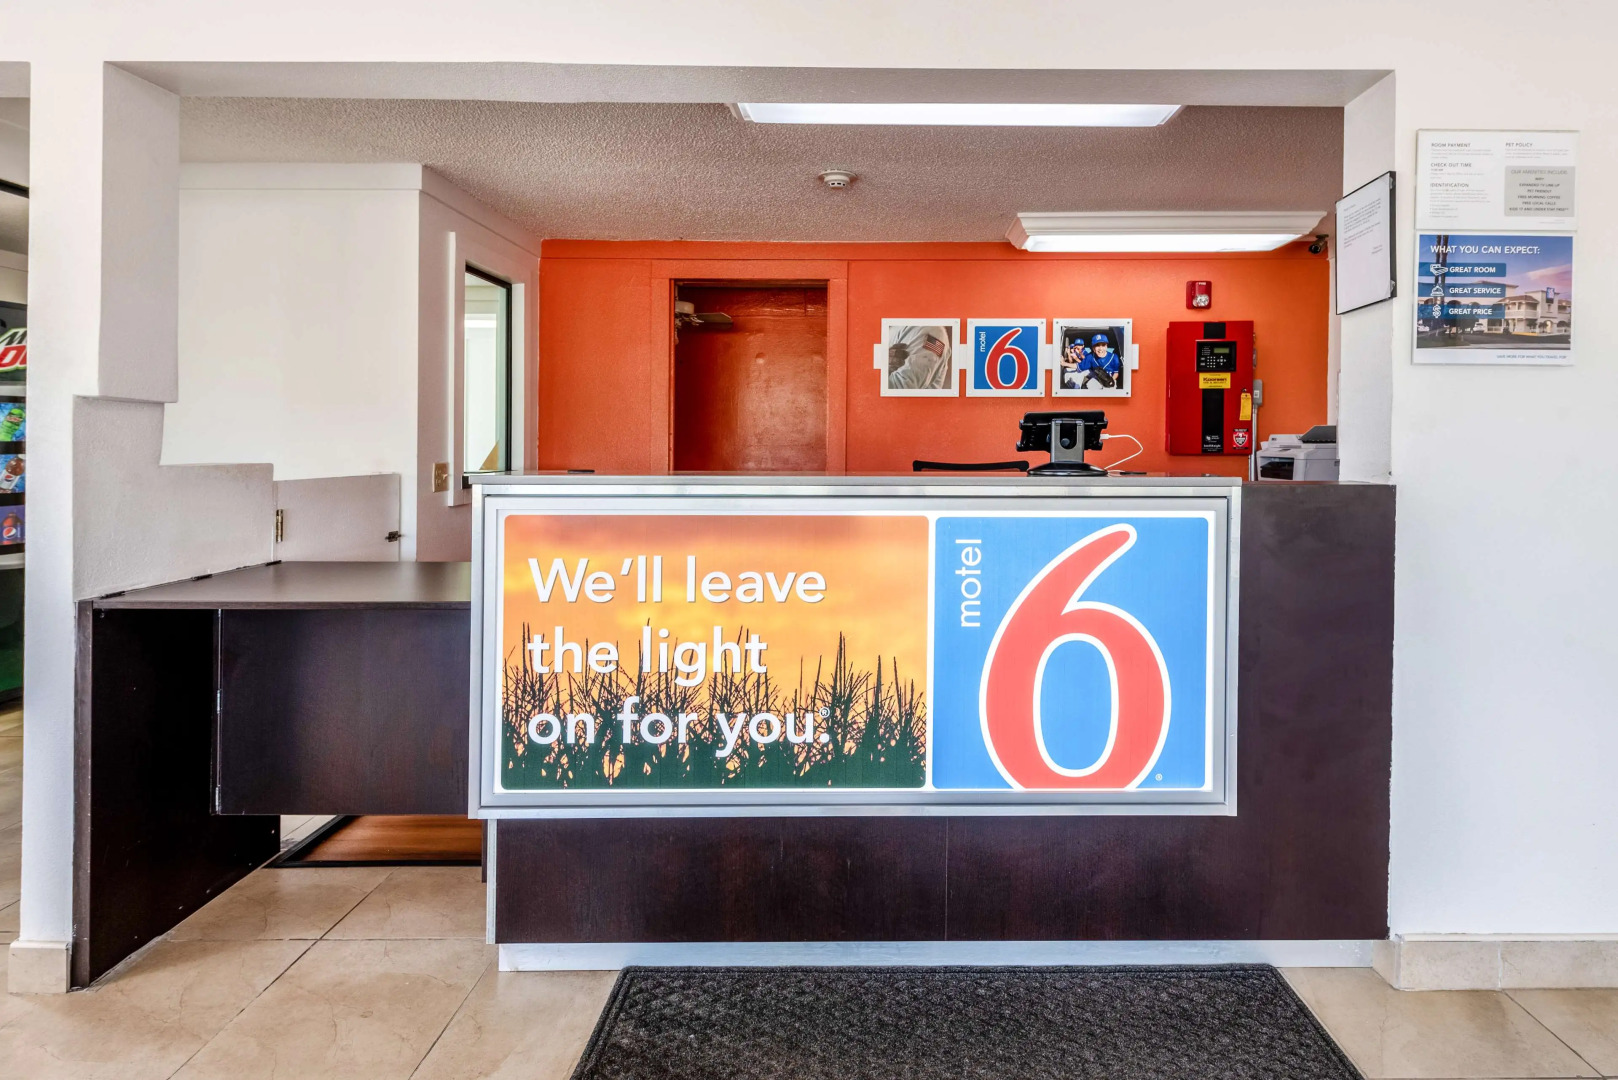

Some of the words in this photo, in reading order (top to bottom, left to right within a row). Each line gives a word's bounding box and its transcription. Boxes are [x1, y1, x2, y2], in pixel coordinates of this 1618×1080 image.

[1430, 246, 1457, 254] WHAT
[1460, 246, 1479, 254] YOU
[1482, 246, 1501, 254] CAN
[1504, 246, 1540, 254] EXPECT:
[985, 327, 1030, 389] 6
[528, 555, 662, 603] We'll
[687, 555, 827, 603] leave
[955, 539, 982, 628] motel
[528, 626, 619, 674] the
[642, 626, 768, 687] light
[978, 522, 1172, 792] 6
[528, 711, 594, 744] on
[617, 696, 698, 744] for
